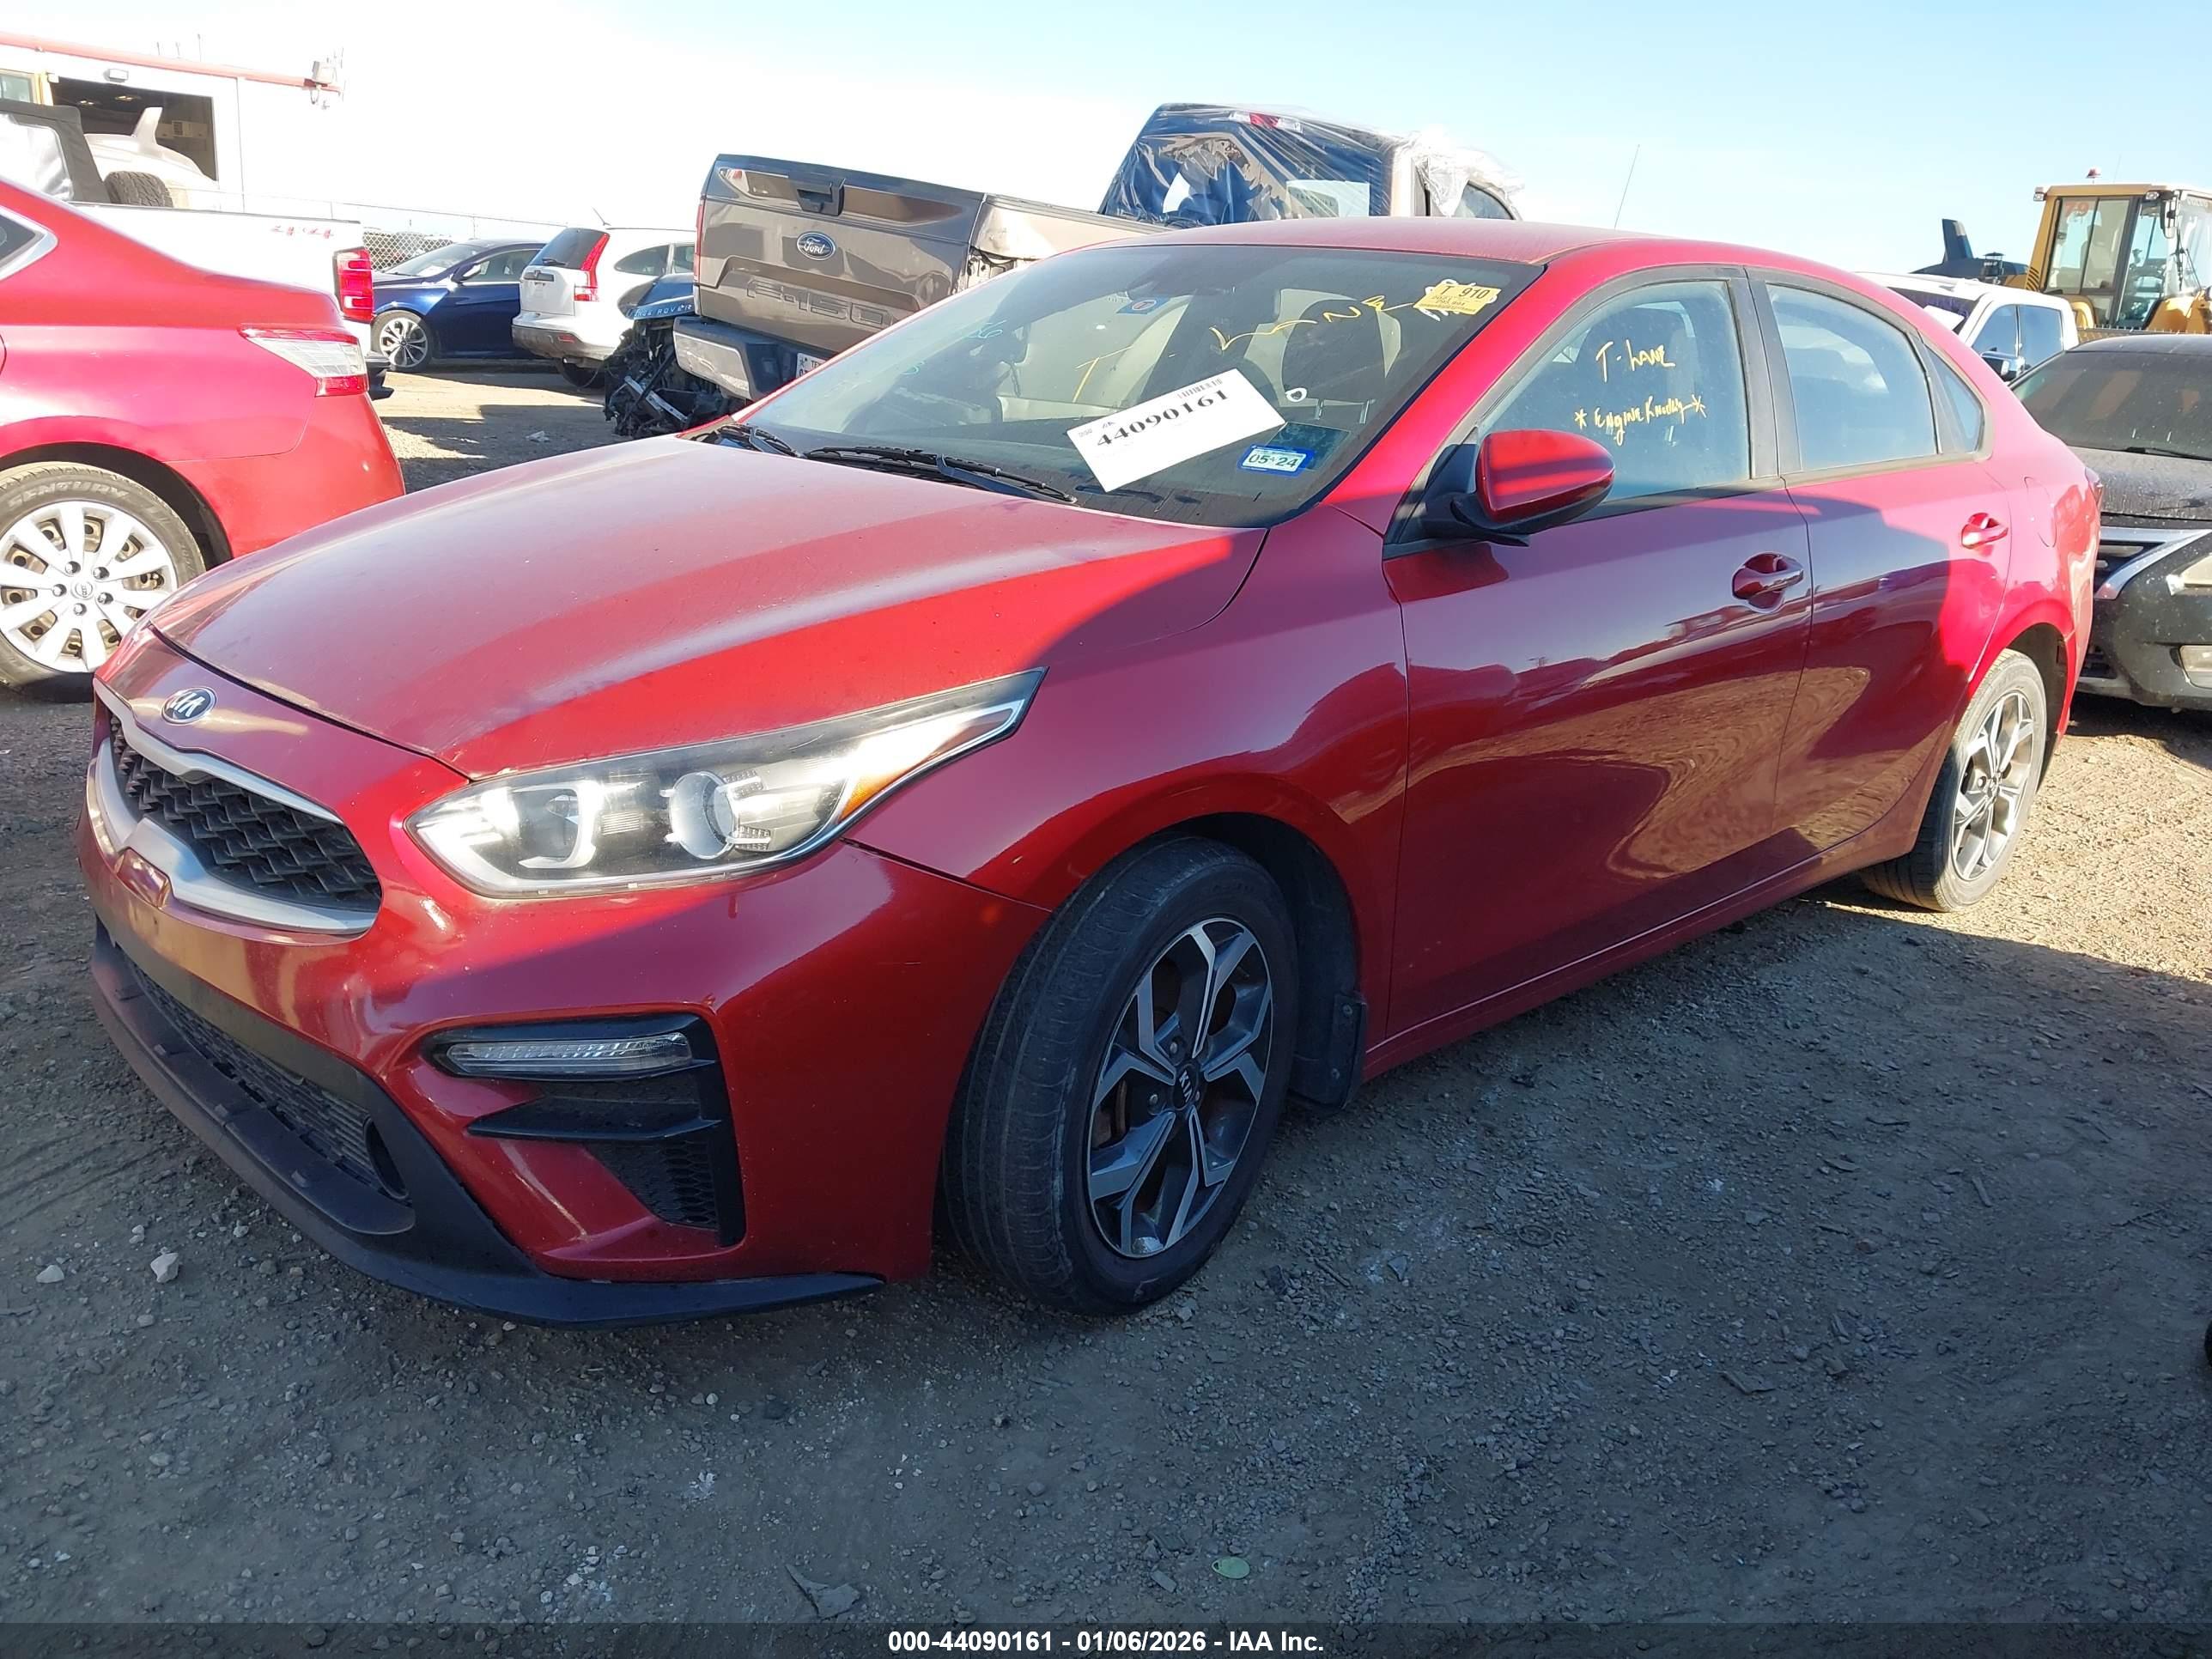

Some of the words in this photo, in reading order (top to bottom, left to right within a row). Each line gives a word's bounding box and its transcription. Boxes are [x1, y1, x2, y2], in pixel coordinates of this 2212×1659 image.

[746, 276, 896, 332] F-150
[1441, 286, 1455, 295] T
[1459, 287, 1491, 300] 910
[1097, 389, 1228, 447] 44090161
[1249, 453, 1269, 465] 05
[1275, 457, 1299, 468] 24
[1179, 1070, 1193, 1103] KIA
